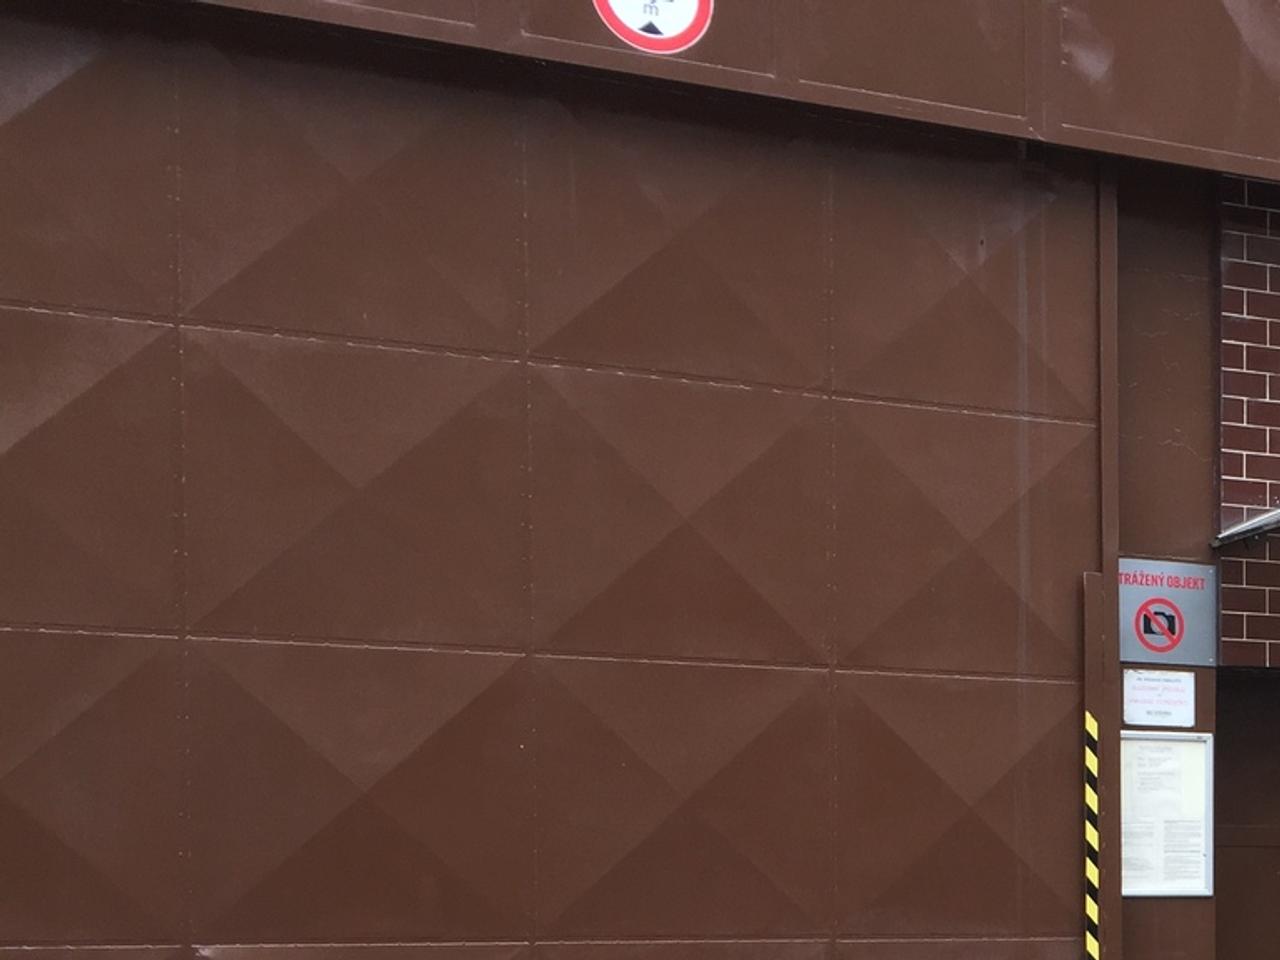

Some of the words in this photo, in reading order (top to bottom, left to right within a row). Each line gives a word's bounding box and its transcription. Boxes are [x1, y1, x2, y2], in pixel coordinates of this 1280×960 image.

[643, 3, 660, 16] m
[1119, 570, 1165, 587] TRÁŽENÝ
[1167, 575, 1206, 590] OBJEKT
